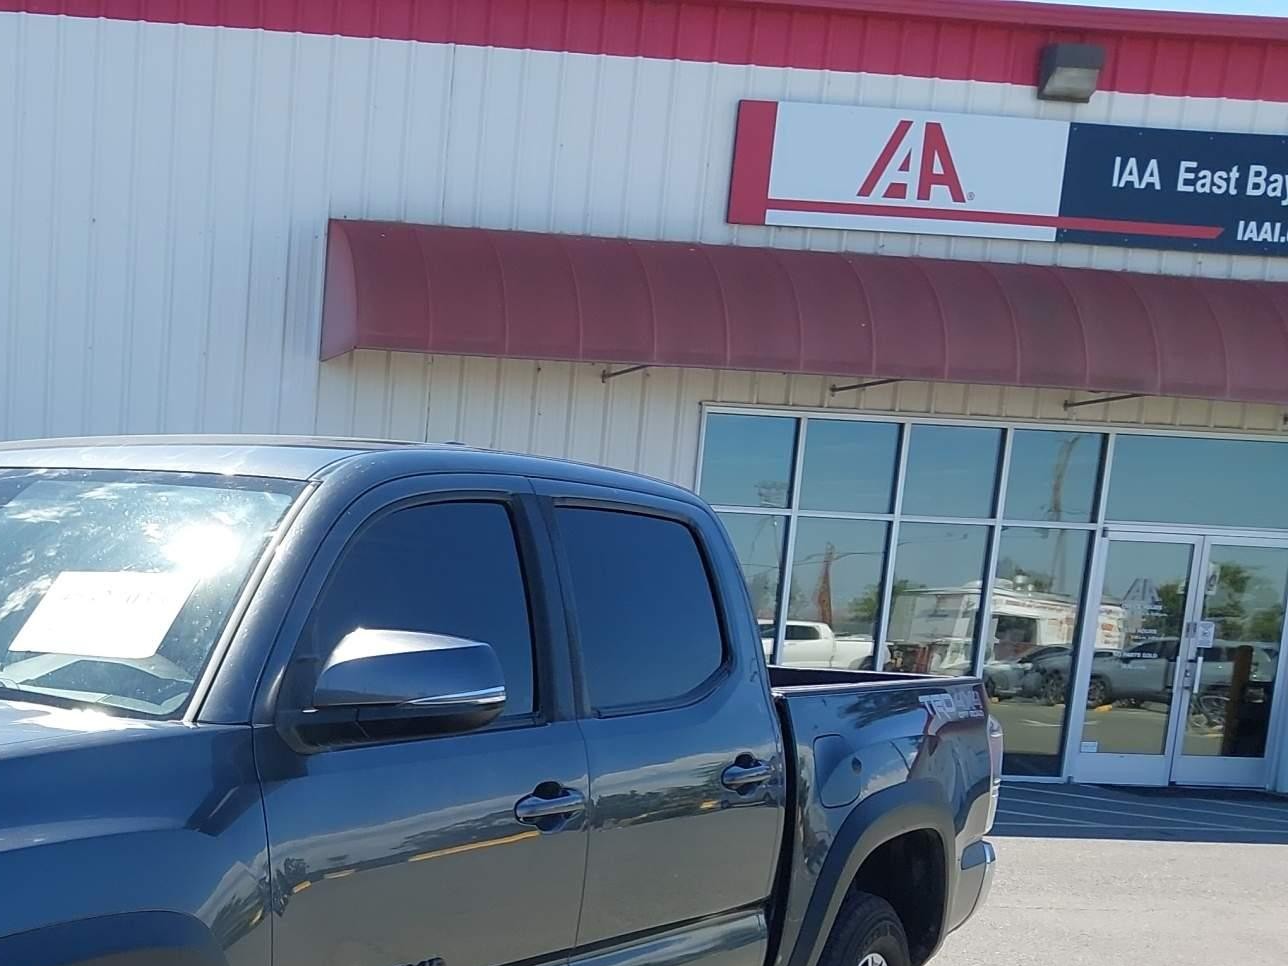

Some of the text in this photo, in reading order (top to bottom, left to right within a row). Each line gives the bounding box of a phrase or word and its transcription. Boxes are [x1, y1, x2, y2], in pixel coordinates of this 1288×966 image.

[1112, 156, 1161, 190] IAA
[1177, 160, 1240, 195] East
[1237, 220, 1288, 243] IAAI.
